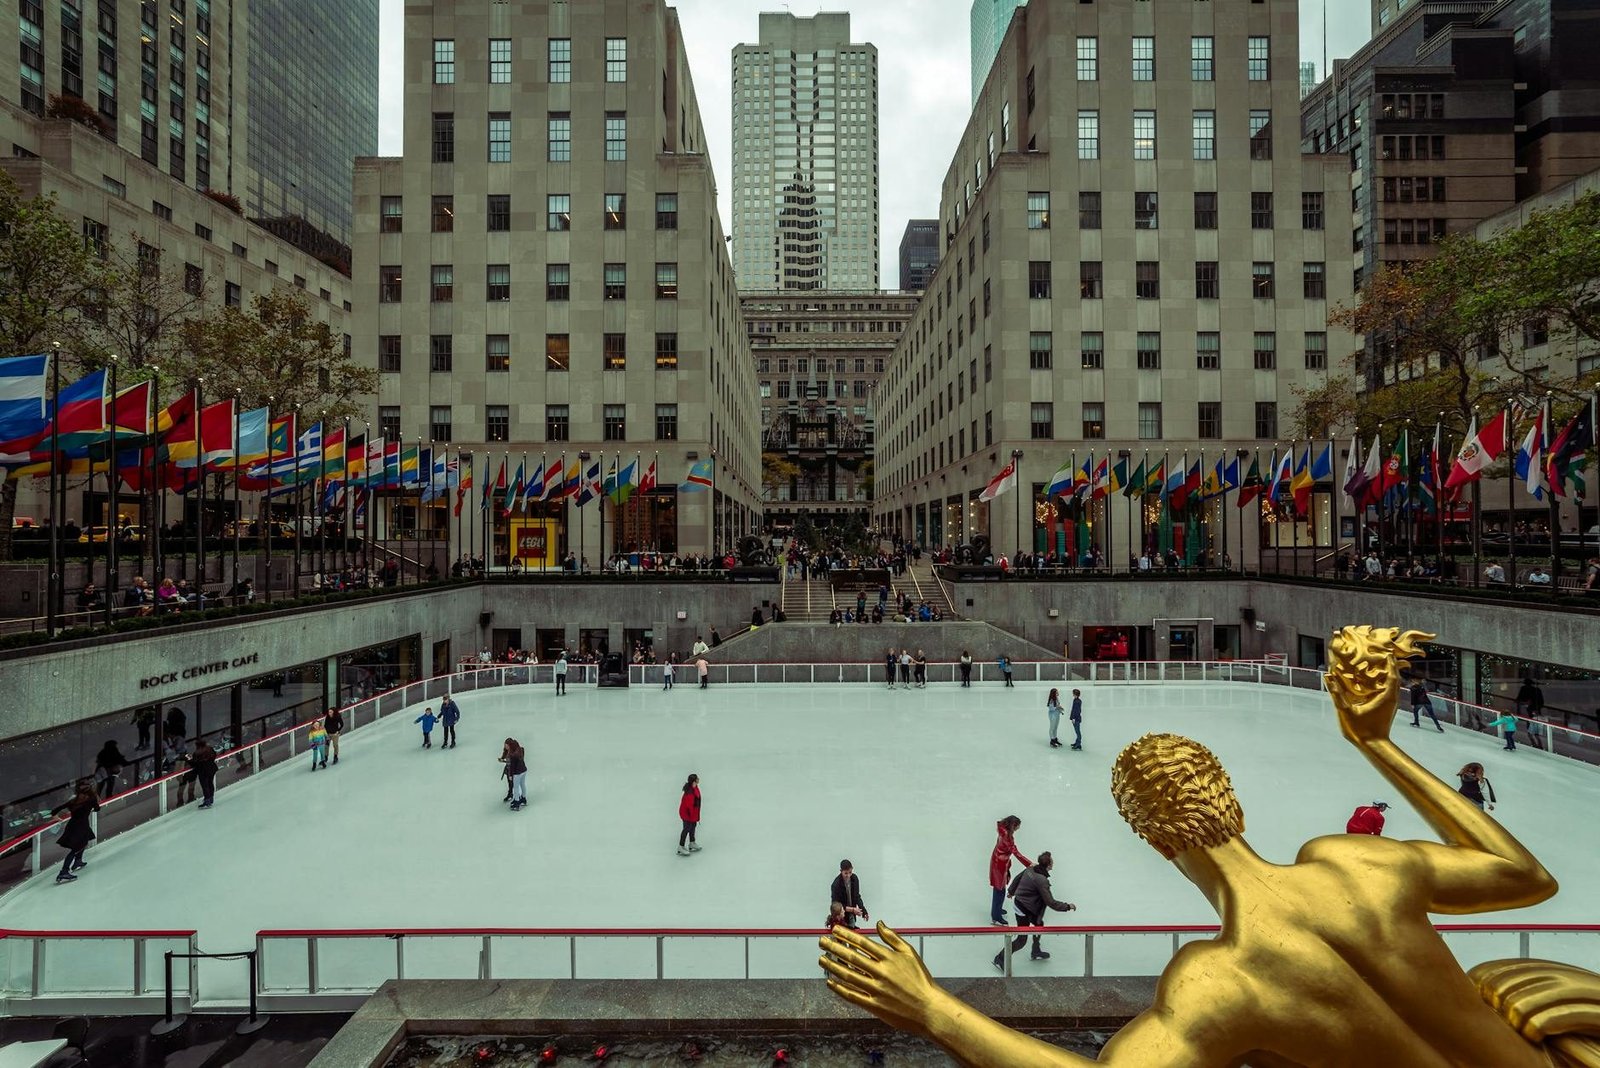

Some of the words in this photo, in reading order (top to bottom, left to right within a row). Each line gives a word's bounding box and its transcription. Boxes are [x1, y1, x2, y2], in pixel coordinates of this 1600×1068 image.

[140, 672, 178, 689] ROCK
[182, 661, 228, 679] CENTER
[232, 652, 258, 667] CAFÉ
